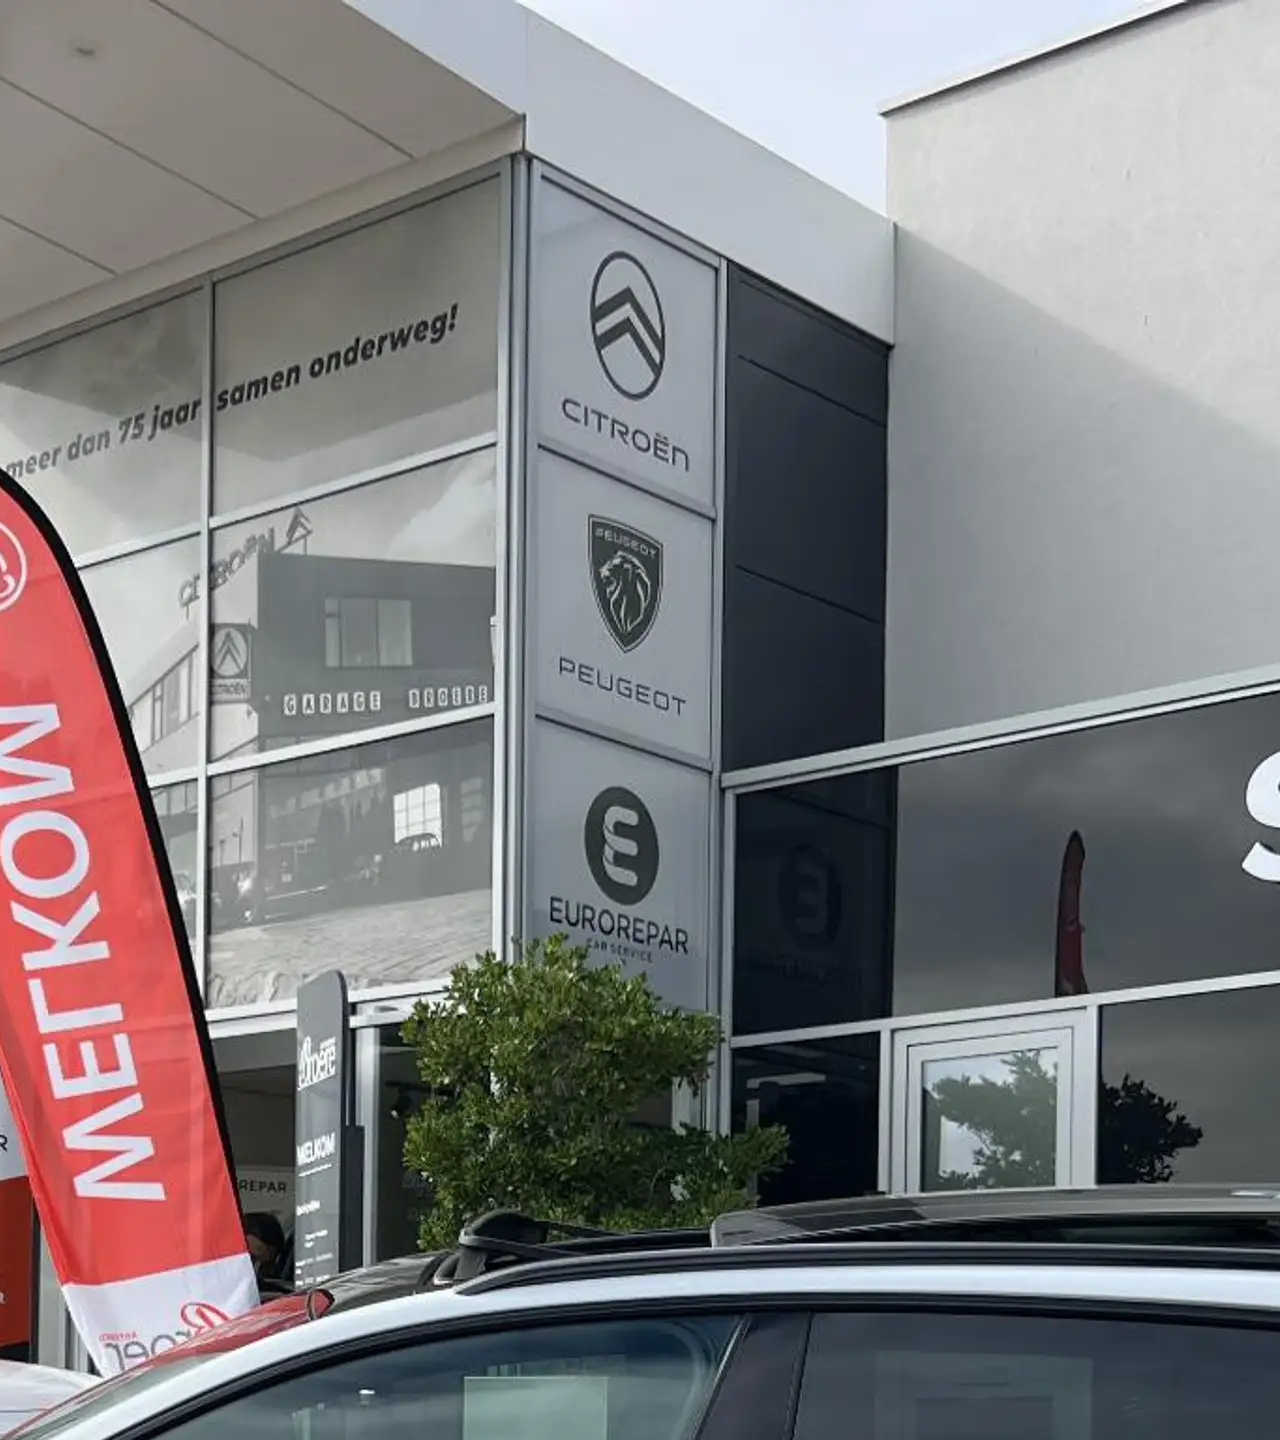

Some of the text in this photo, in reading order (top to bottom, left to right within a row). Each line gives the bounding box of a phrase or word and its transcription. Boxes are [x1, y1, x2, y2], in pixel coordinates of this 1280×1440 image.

[6, 303, 459, 478] meer dan 75 jaar samen onderweg!
[559, 656, 687, 717] PEUGEOT
[549, 896, 689, 956] EUROREPAR
